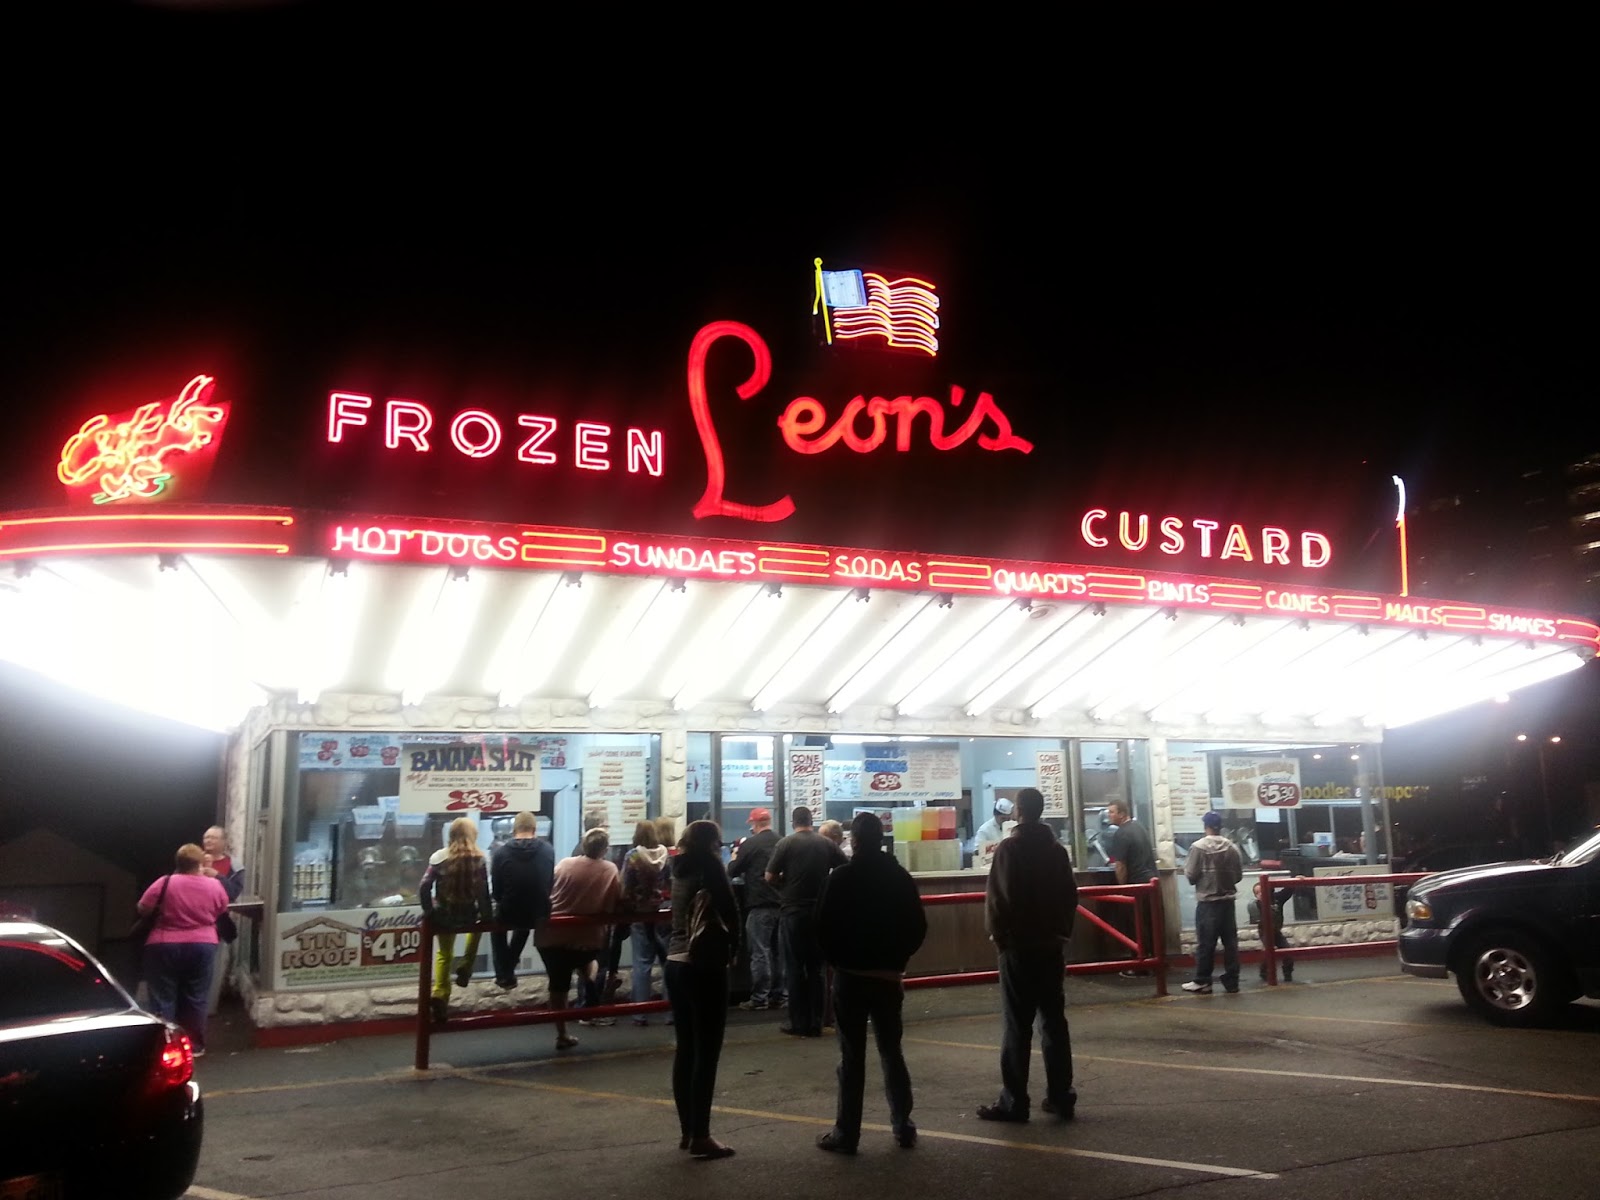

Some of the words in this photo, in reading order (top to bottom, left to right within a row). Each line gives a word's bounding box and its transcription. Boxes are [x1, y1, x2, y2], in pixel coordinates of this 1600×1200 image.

[687, 319, 1034, 523] Leon's
[327, 391, 664, 478] FROZEN
[332, 525, 408, 556] HOT
[417, 529, 520, 561] DOGS
[1080, 508, 1332, 569] CUSTARD
[609, 541, 757, 576] SUNDAES
[833, 554, 922, 583] SODAS
[992, 568, 1088, 596] QUARTS
[1147, 579, 1210, 605] PINTS
[1264, 589, 1331, 614] CONES
[1384, 601, 1443, 627] MALTS
[1488, 611, 1557, 637] SHAKES
[410, 748, 486, 772] BANANA
[488, 748, 536, 772] SPLIT
[791, 753, 820, 764] CONE
[296, 932, 347, 950] TIN
[281, 947, 359, 970] ROOF
